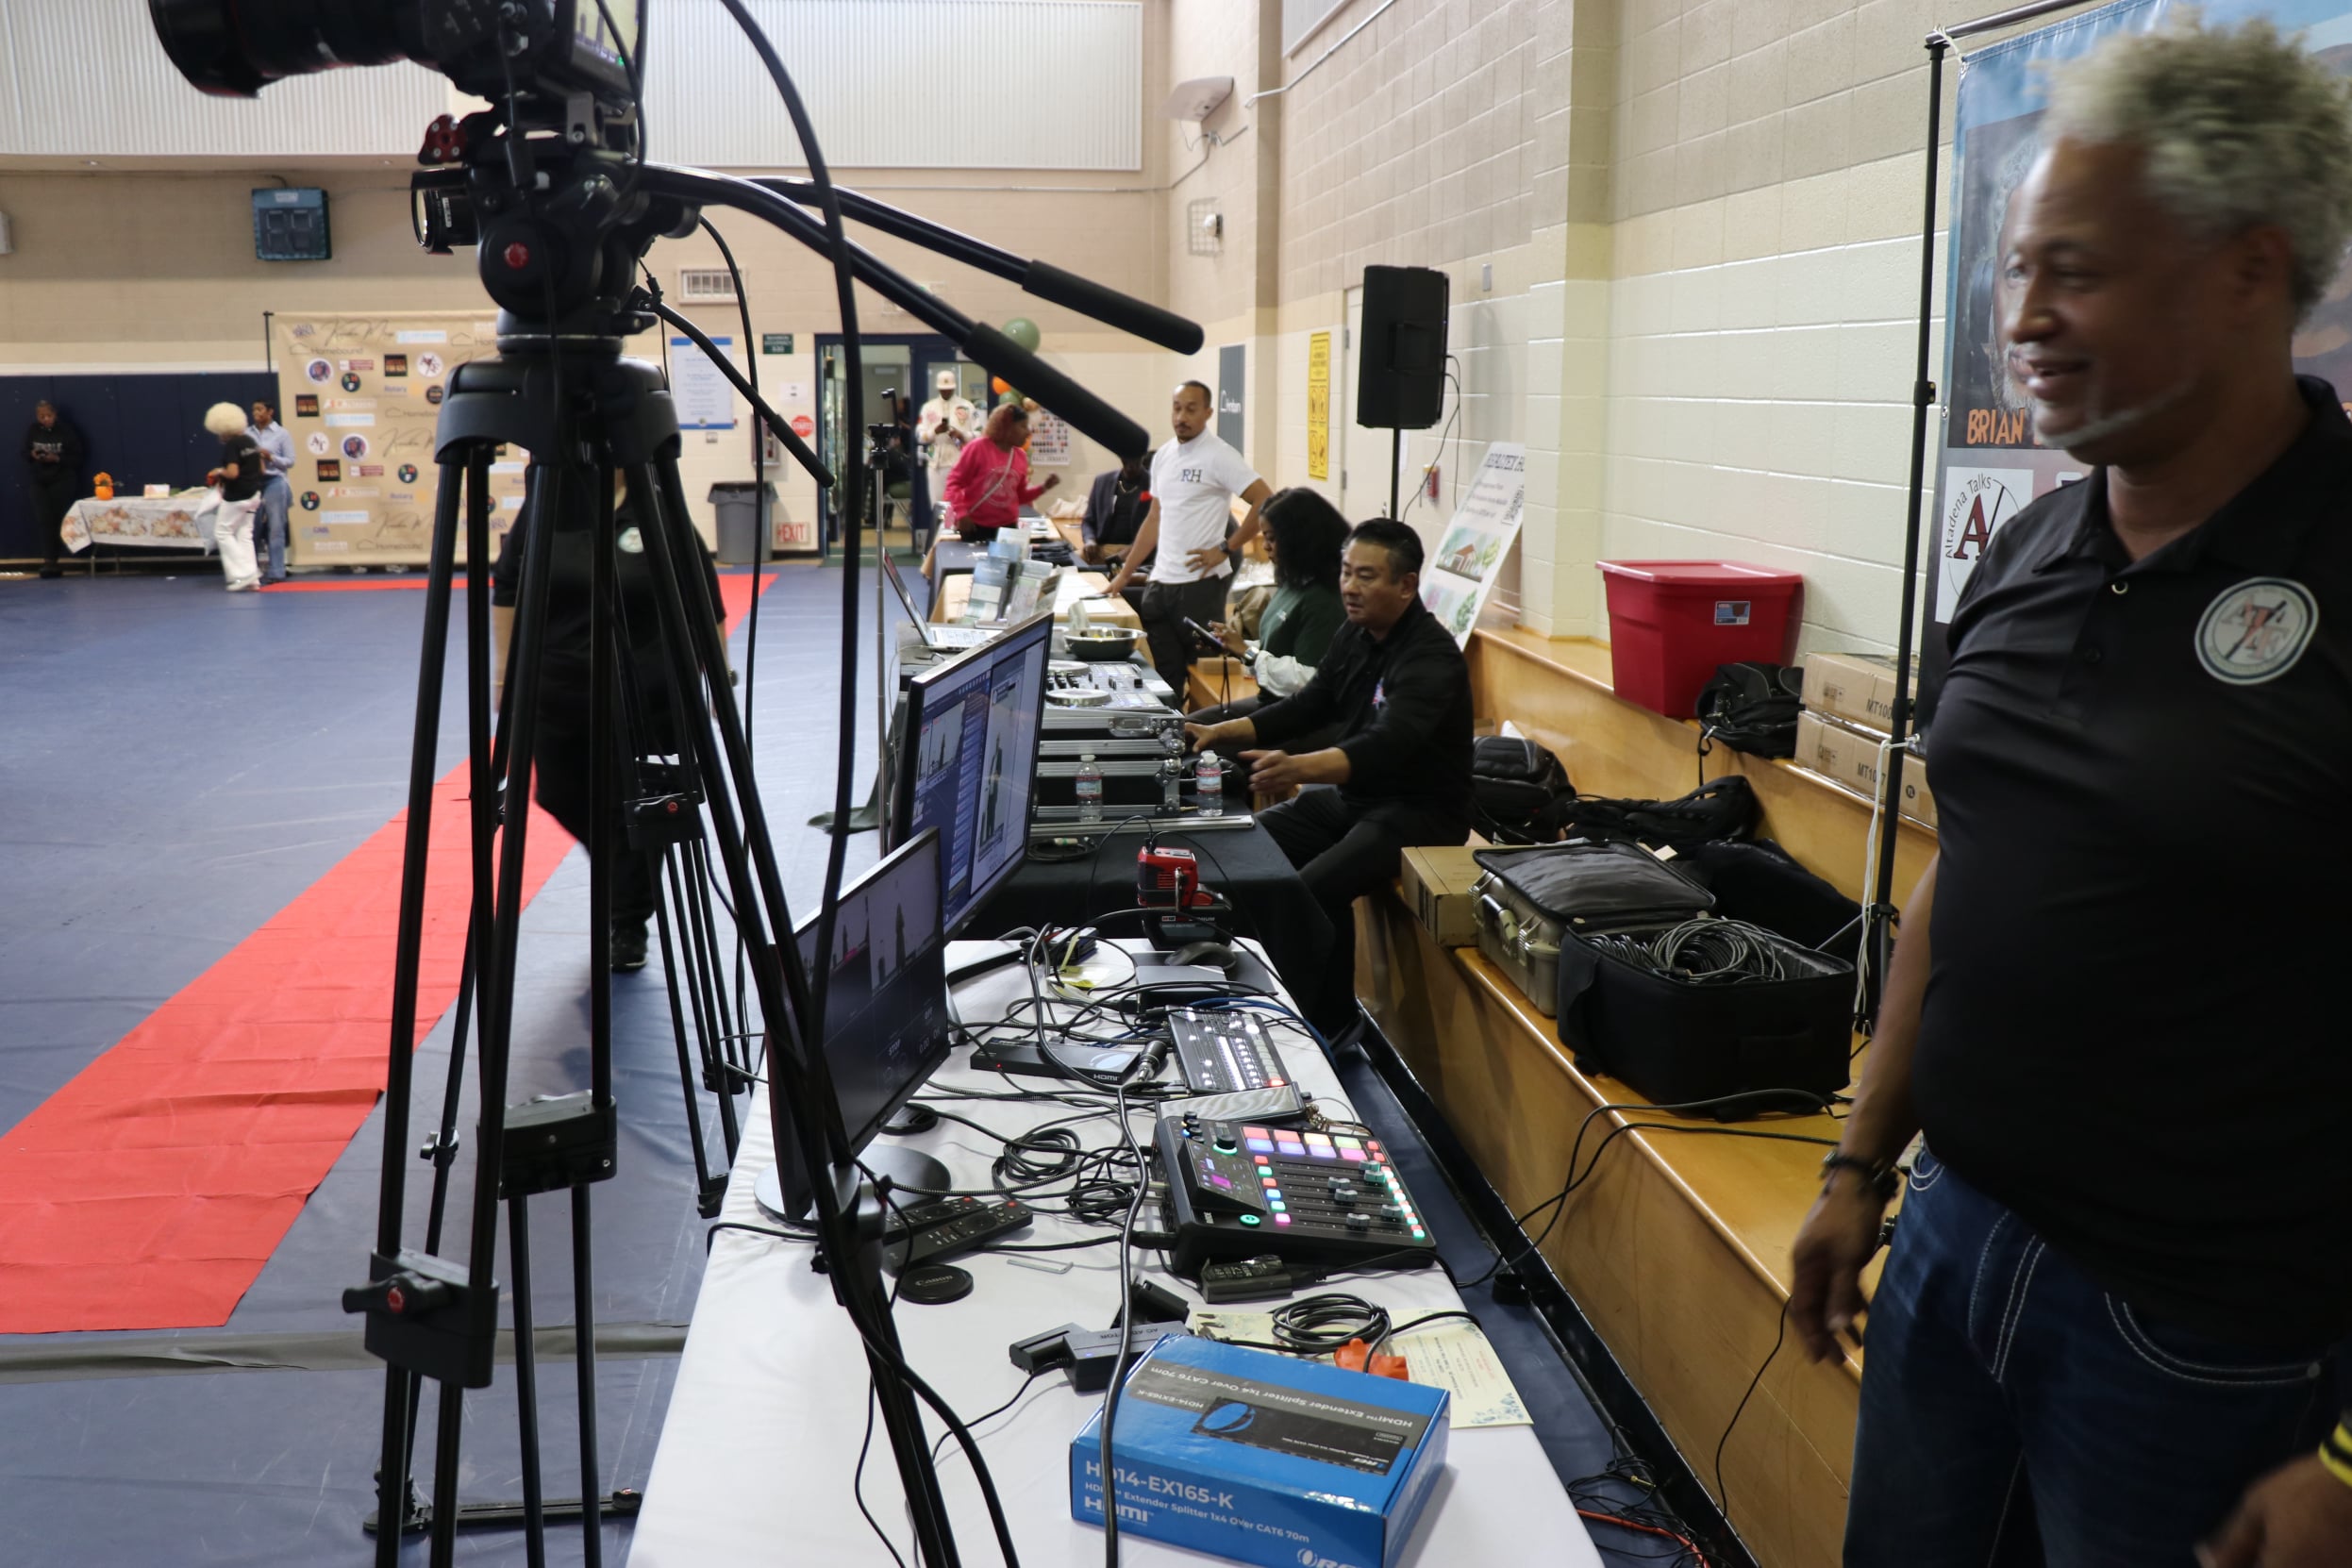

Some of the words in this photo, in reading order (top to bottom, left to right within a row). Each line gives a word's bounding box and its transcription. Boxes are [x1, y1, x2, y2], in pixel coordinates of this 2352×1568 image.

[1967, 407, 2026, 445] BRIAN
[1181, 468, 1203, 482] RH
[1944, 491, 1968, 559] Altadena
[1966, 473, 1993, 494] Talks
[782, 524, 806, 542] EXIT
[1866, 699, 1893, 720] MT100
[1857, 762, 1887, 786] MT107
[1093, 1074, 1119, 1082] HDMI
[915, 1275, 954, 1287] Canon
[1100, 1331, 1143, 1340] ADTOR
[1150, 1366, 1176, 1377] 70m
[1177, 1373, 1209, 1384] CAT6
[1211, 1380, 1239, 1392] Over
[1241, 1386, 1260, 1396] 1x4
[1261, 1391, 1308, 1407] Splitter
[1309, 1401, 1364, 1418] Extender
[1124, 1492, 1169, 1510] Extender
[1171, 1503, 1209, 1519] Splitter
[1210, 1512, 1227, 1523] 1x4
[1256, 1524, 1284, 1537] CAT6
[1285, 1530, 1310, 1543] 70m
